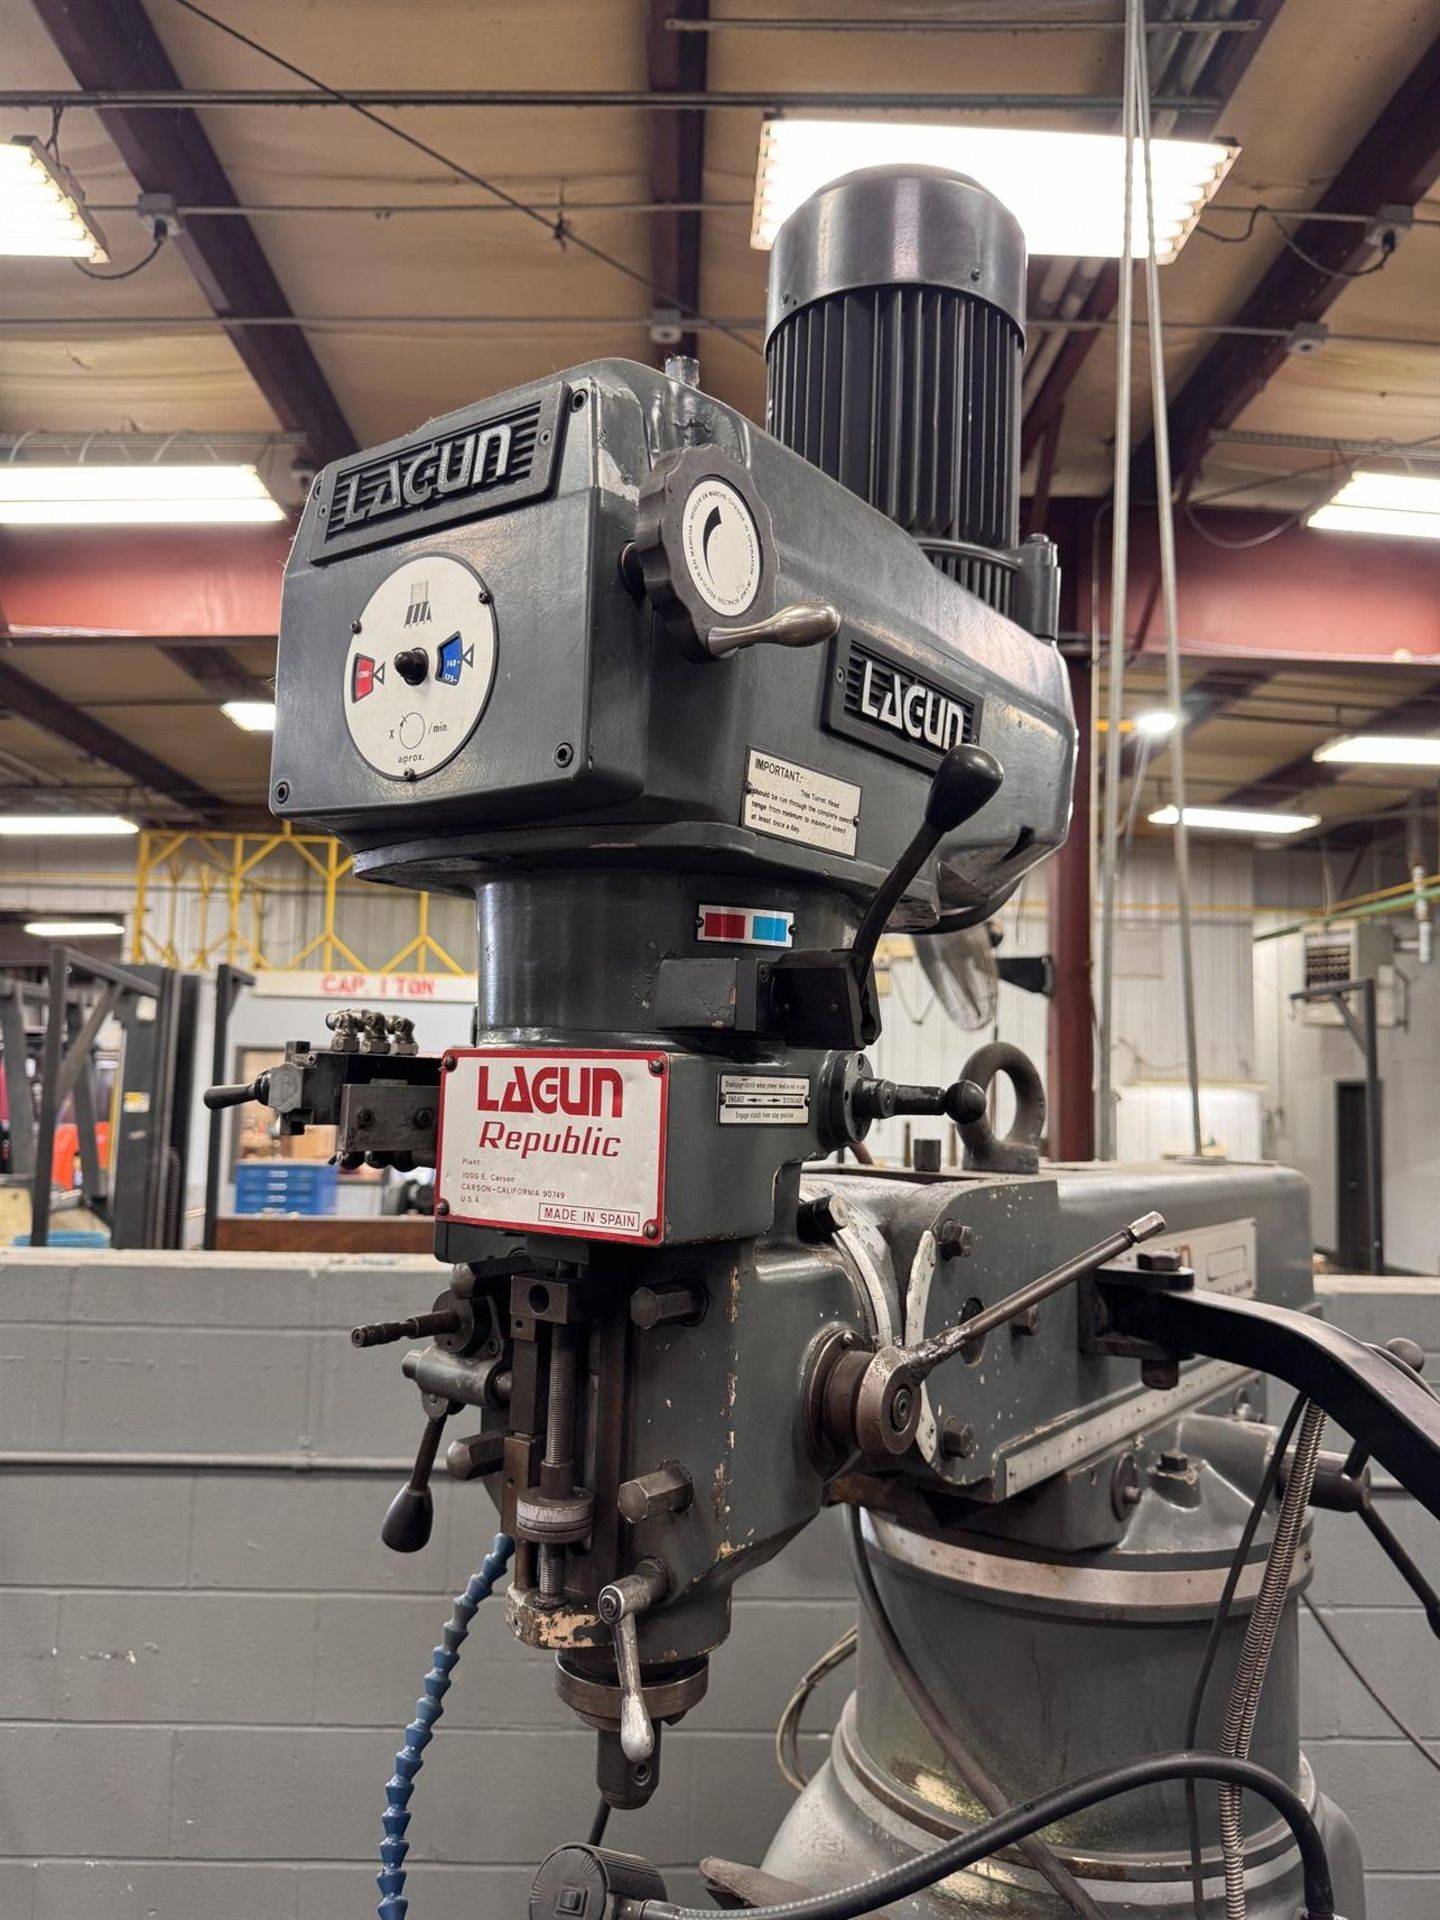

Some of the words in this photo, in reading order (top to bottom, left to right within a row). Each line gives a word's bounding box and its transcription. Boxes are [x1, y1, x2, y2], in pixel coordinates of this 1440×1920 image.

[344, 423, 512, 526] LAGUN
[861, 660, 965, 750] LAGUN
[754, 758, 804, 783] IMPORTANT:
[478, 1066, 624, 1118] LAGUN
[478, 1120, 621, 1159] Republic
[490, 1174, 515, 1182] Carson
[542, 1191, 566, 1199] 90749
[544, 1206, 577, 1221] MADE
[583, 1210, 595, 1223] IN
[600, 1212, 636, 1228] SPAIN
